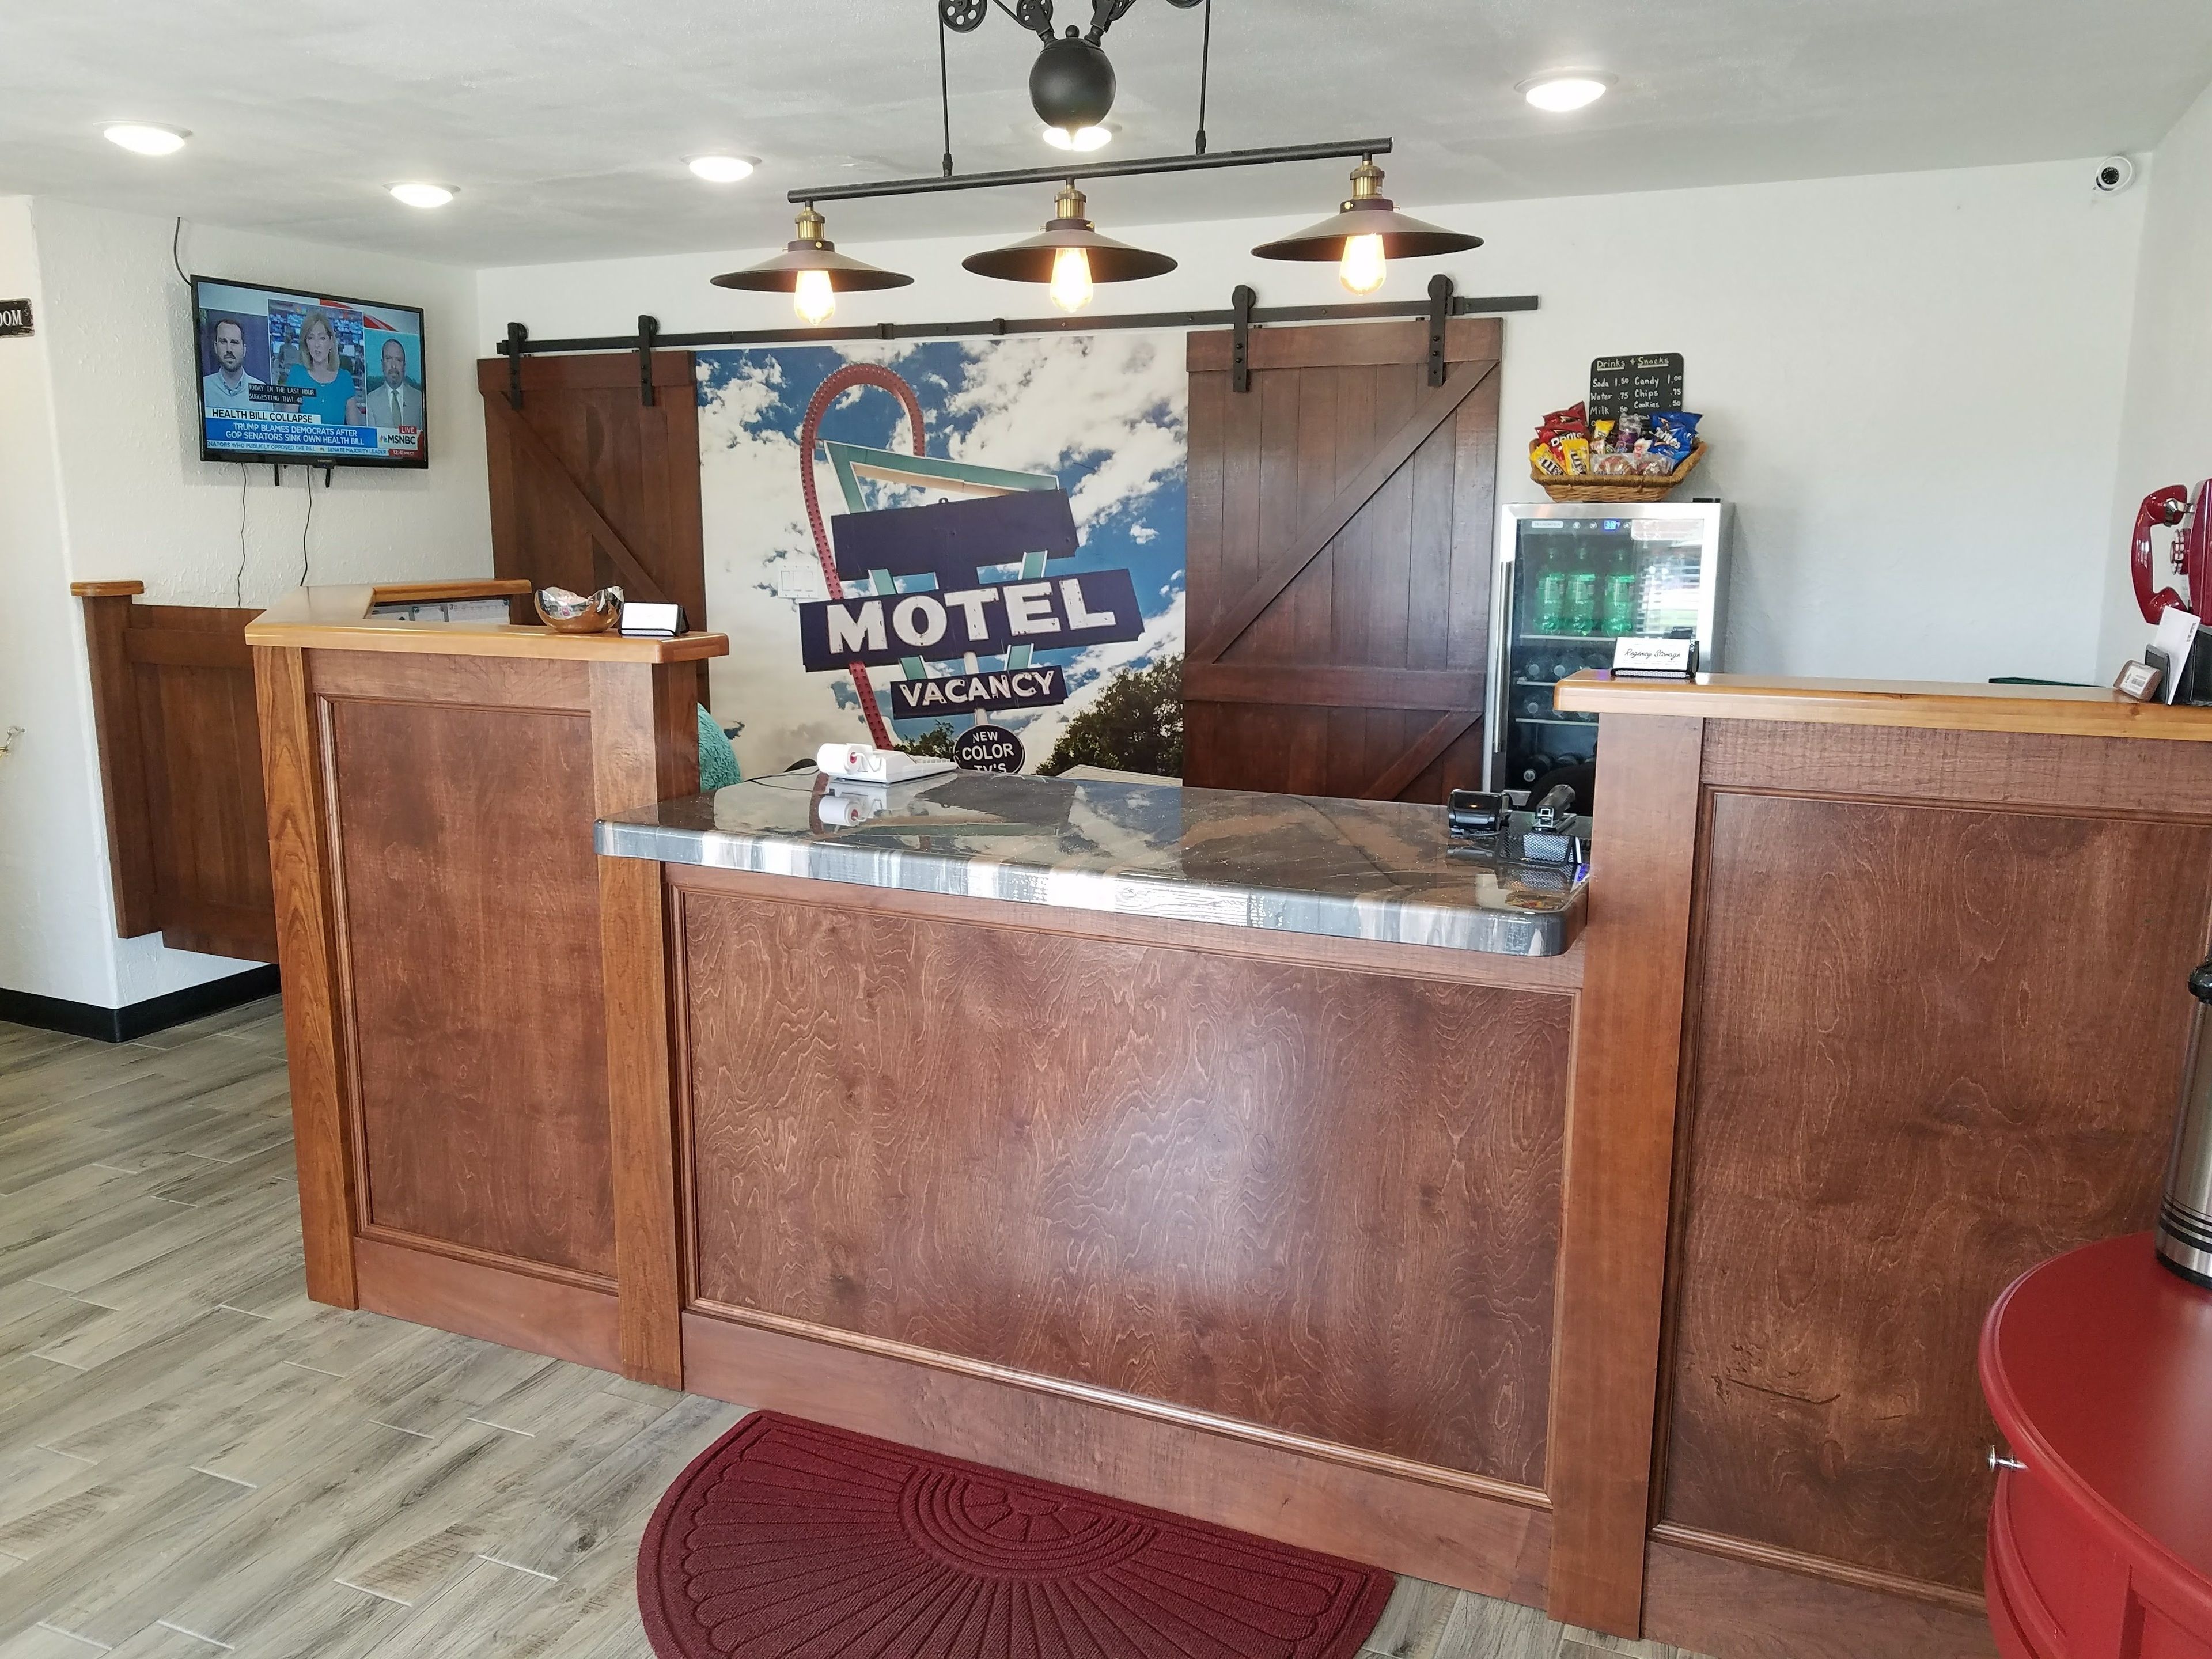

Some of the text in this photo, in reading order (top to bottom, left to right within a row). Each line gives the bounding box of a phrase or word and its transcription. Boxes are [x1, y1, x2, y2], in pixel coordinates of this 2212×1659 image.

[1597, 358, 1625, 369] Drinks
[1638, 356, 1669, 366] Snacks
[1592, 377, 1609, 388] Soda
[1634, 376, 1660, 388] Candy
[248, 393, 280, 401] SUGGESTING
[1590, 392, 1613, 401] Water
[1634, 389, 1659, 401] Chips
[1589, 405, 1610, 415] Milk
[1634, 400, 1660, 409] Cookies
[212, 408, 313, 423] HEALTH BILL COLLAPSE
[233, 422, 259, 431] TRUMP
[261, 424, 289, 433] BLAMES
[291, 426, 334, 435] DEMOCRATS
[244, 432, 283, 441] SENATORS
[303, 435, 321, 443] OWN
[323, 436, 349, 444] HEALTH
[388, 434, 416, 445] MSNBC
[825, 578, 1117, 654] MOTEL
[1624, 648, 1652, 659] Regency
[899, 671, 1055, 707] VACANCY
[972, 730, 998, 743] NEW
[962, 743, 1014, 760] COLOR
